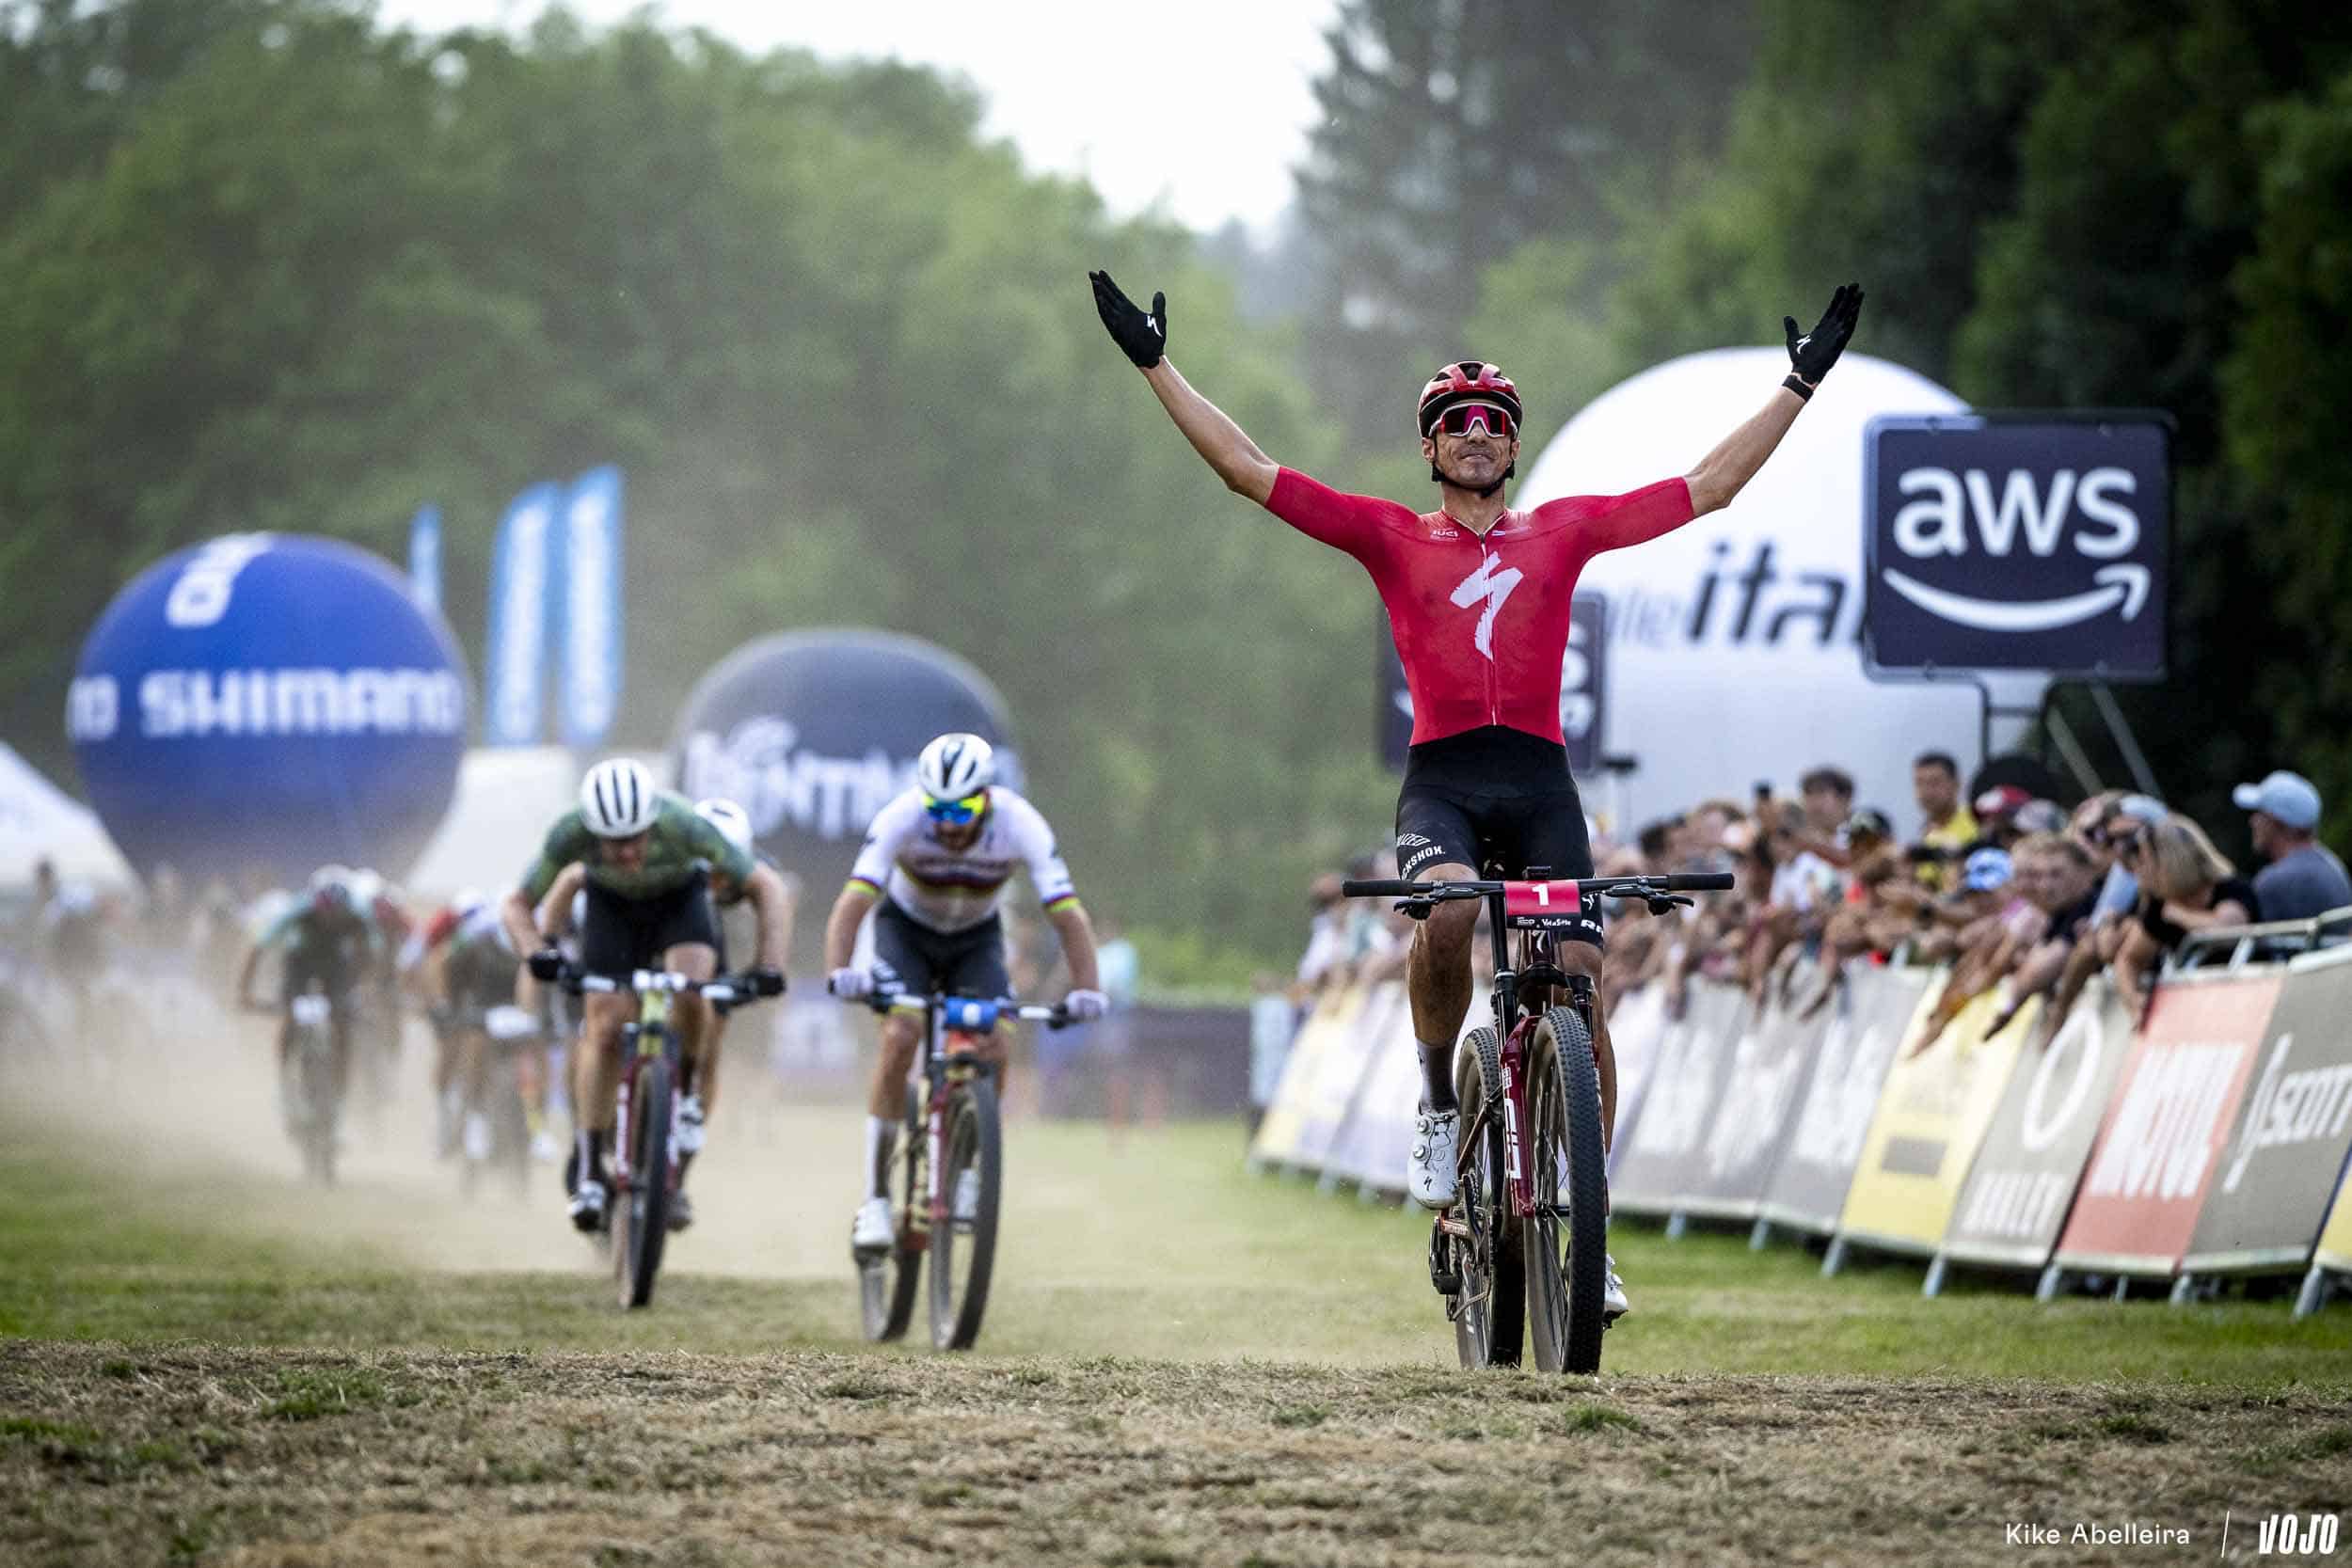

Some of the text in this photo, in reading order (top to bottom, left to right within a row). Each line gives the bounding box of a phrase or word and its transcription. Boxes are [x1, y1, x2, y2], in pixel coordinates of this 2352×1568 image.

[1892, 467, 2142, 559] aws
[1687, 536, 1867, 645] ita
[1532, 883, 1550, 906] 1
